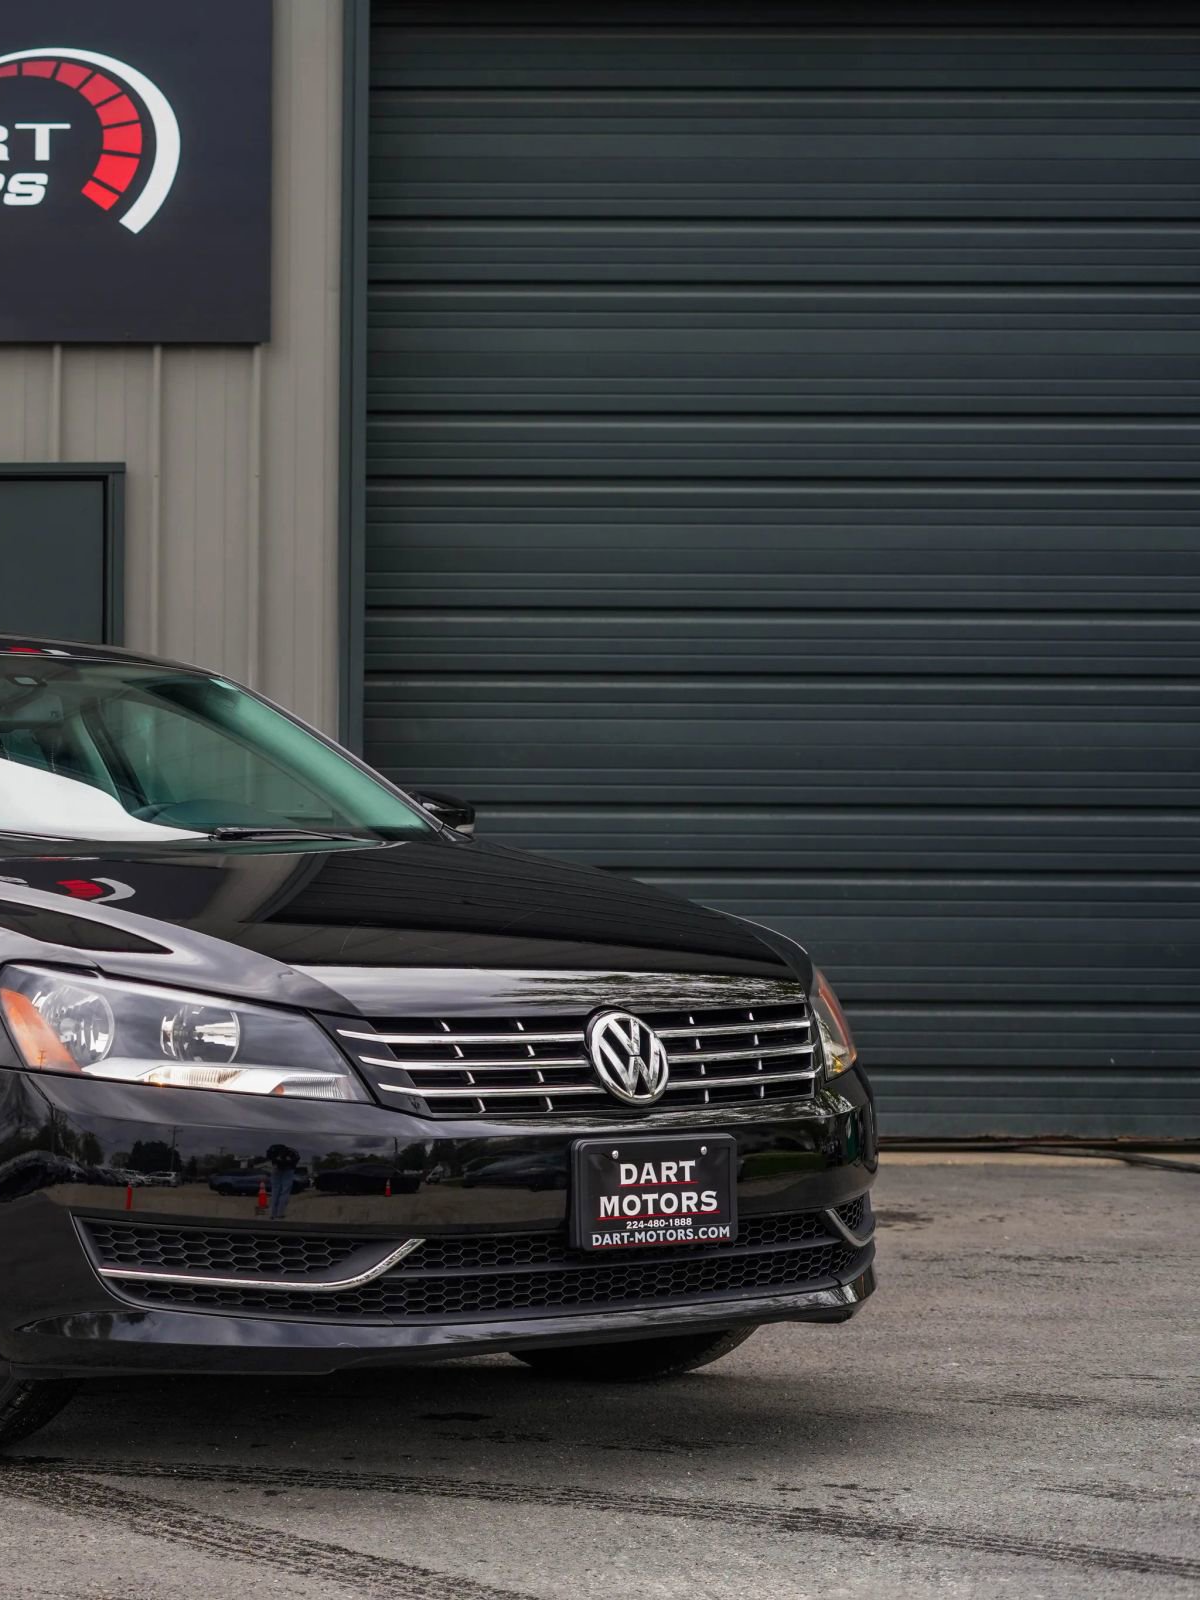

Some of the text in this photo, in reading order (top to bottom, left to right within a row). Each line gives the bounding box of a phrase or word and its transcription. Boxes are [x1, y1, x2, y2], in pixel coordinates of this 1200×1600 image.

[620, 1160, 696, 1185] DART
[600, 1191, 718, 1218] MOTORS
[626, 1217, 692, 1230] 224-480-1888
[592, 1226, 730, 1246] DART-MOTORS.COM
